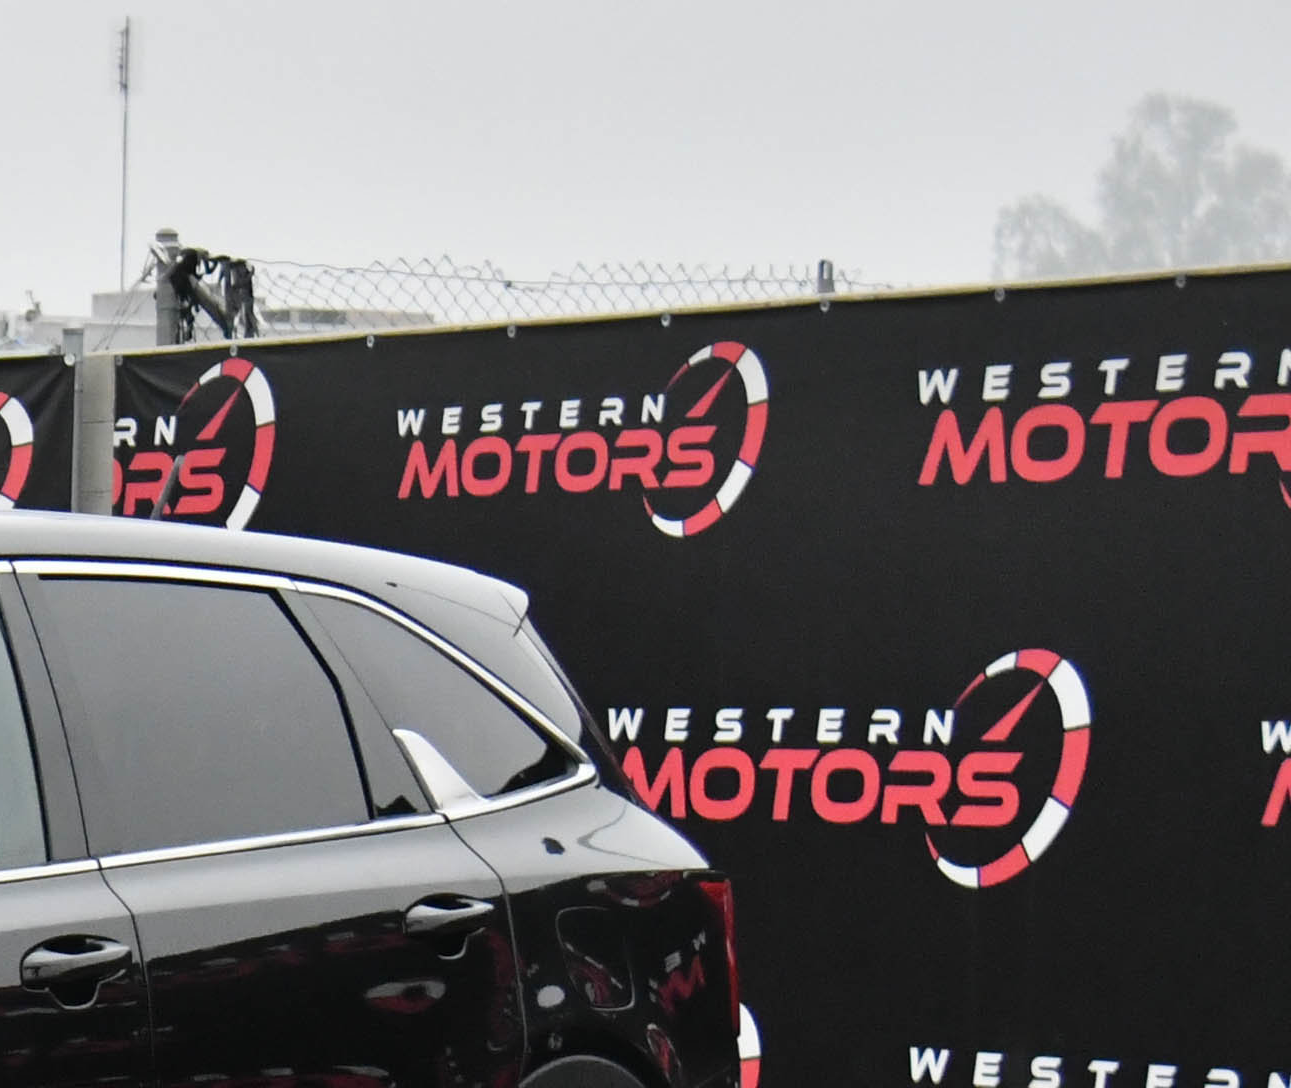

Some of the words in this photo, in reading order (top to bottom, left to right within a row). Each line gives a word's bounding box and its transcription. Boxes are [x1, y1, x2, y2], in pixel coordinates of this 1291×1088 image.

[397, 393, 665, 437] WESTERN
[112, 447, 227, 516] RS
[397, 425, 718, 500] MOTORS
[608, 707, 955, 745] WESTERN
[621, 746, 1023, 827] MOTORS
